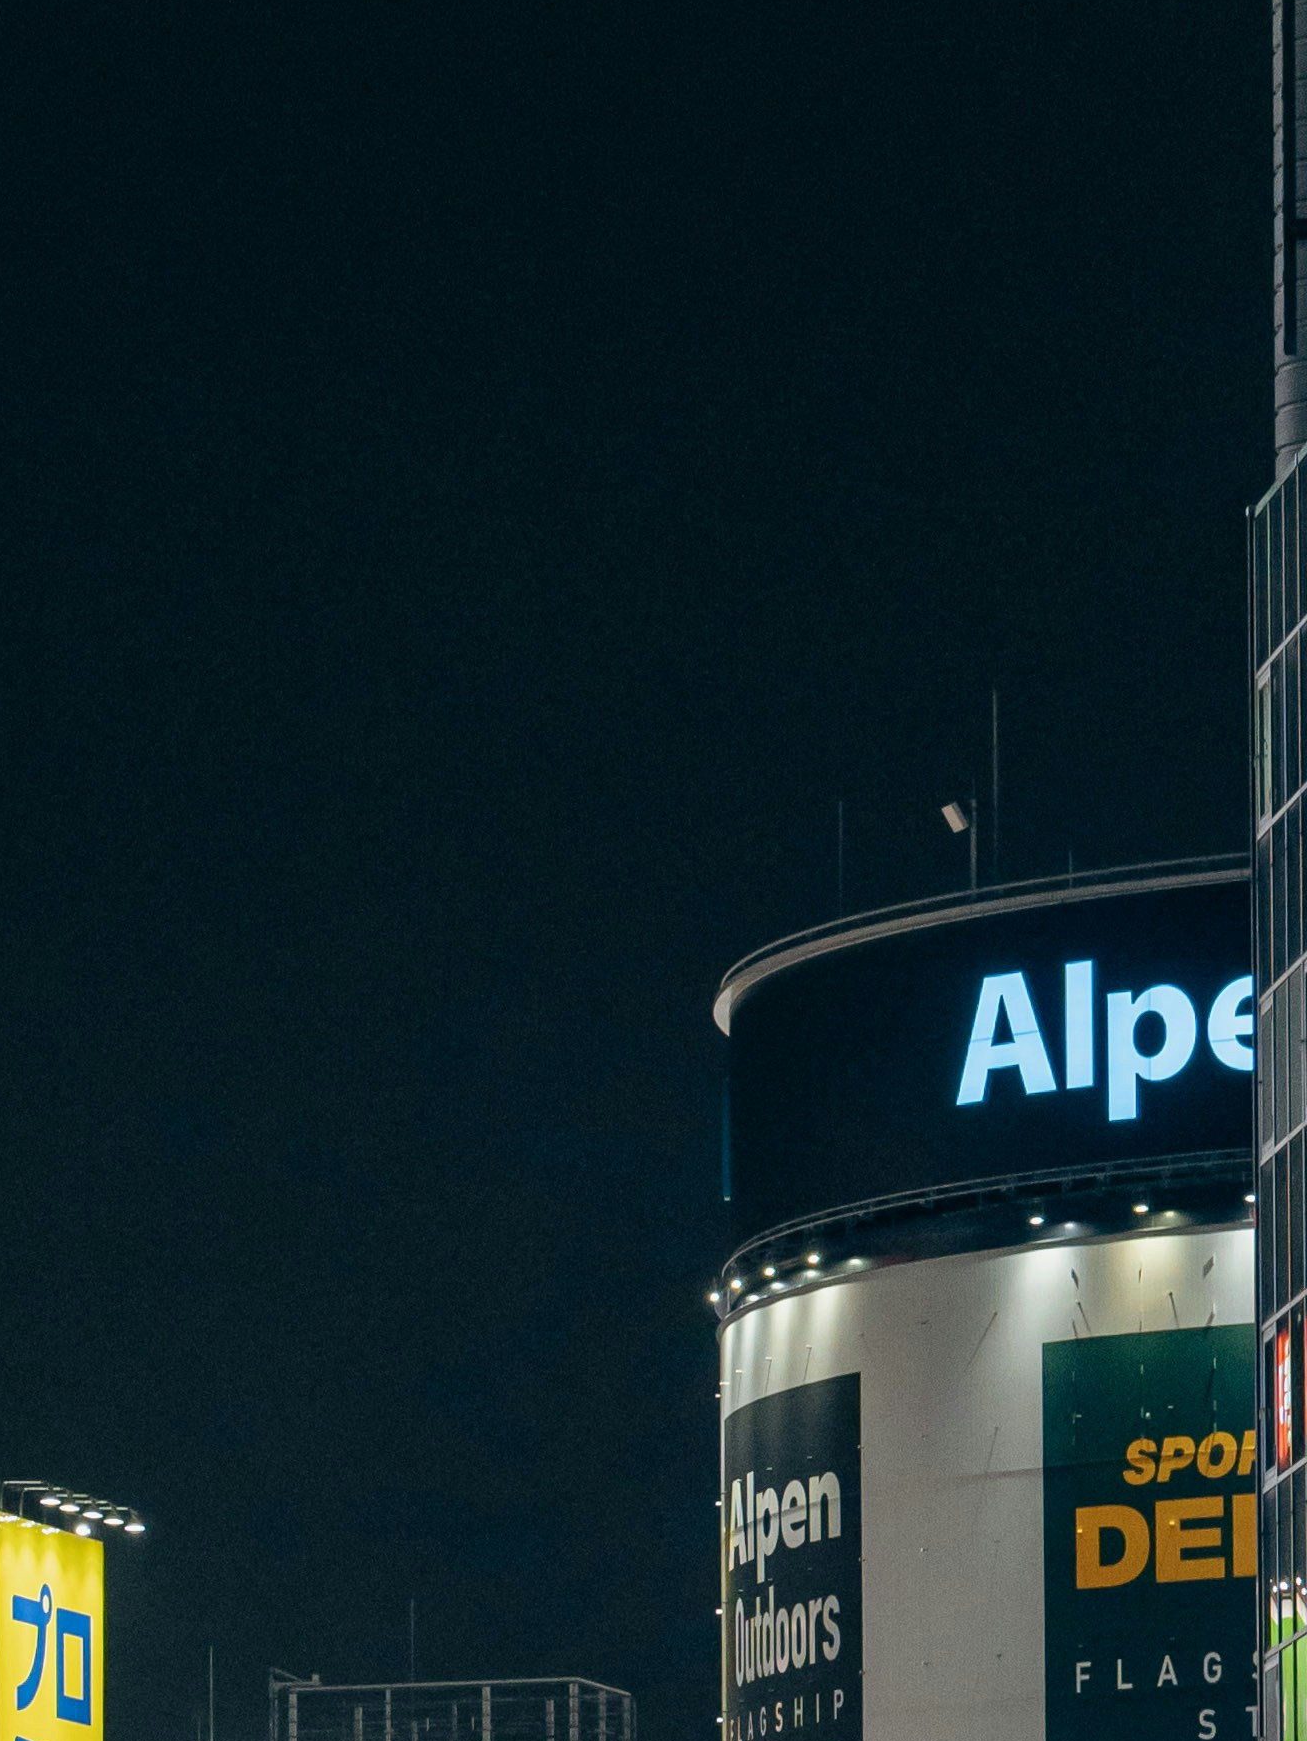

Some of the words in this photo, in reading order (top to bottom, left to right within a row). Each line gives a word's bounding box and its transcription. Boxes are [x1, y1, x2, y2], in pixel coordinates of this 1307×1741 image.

[728, 1468, 842, 1583] Alpen
[11, 1584, 92, 1726] プロ
[733, 1591, 841, 1688] Outdoors
[1075, 1651, 1257, 1692] FLAG
